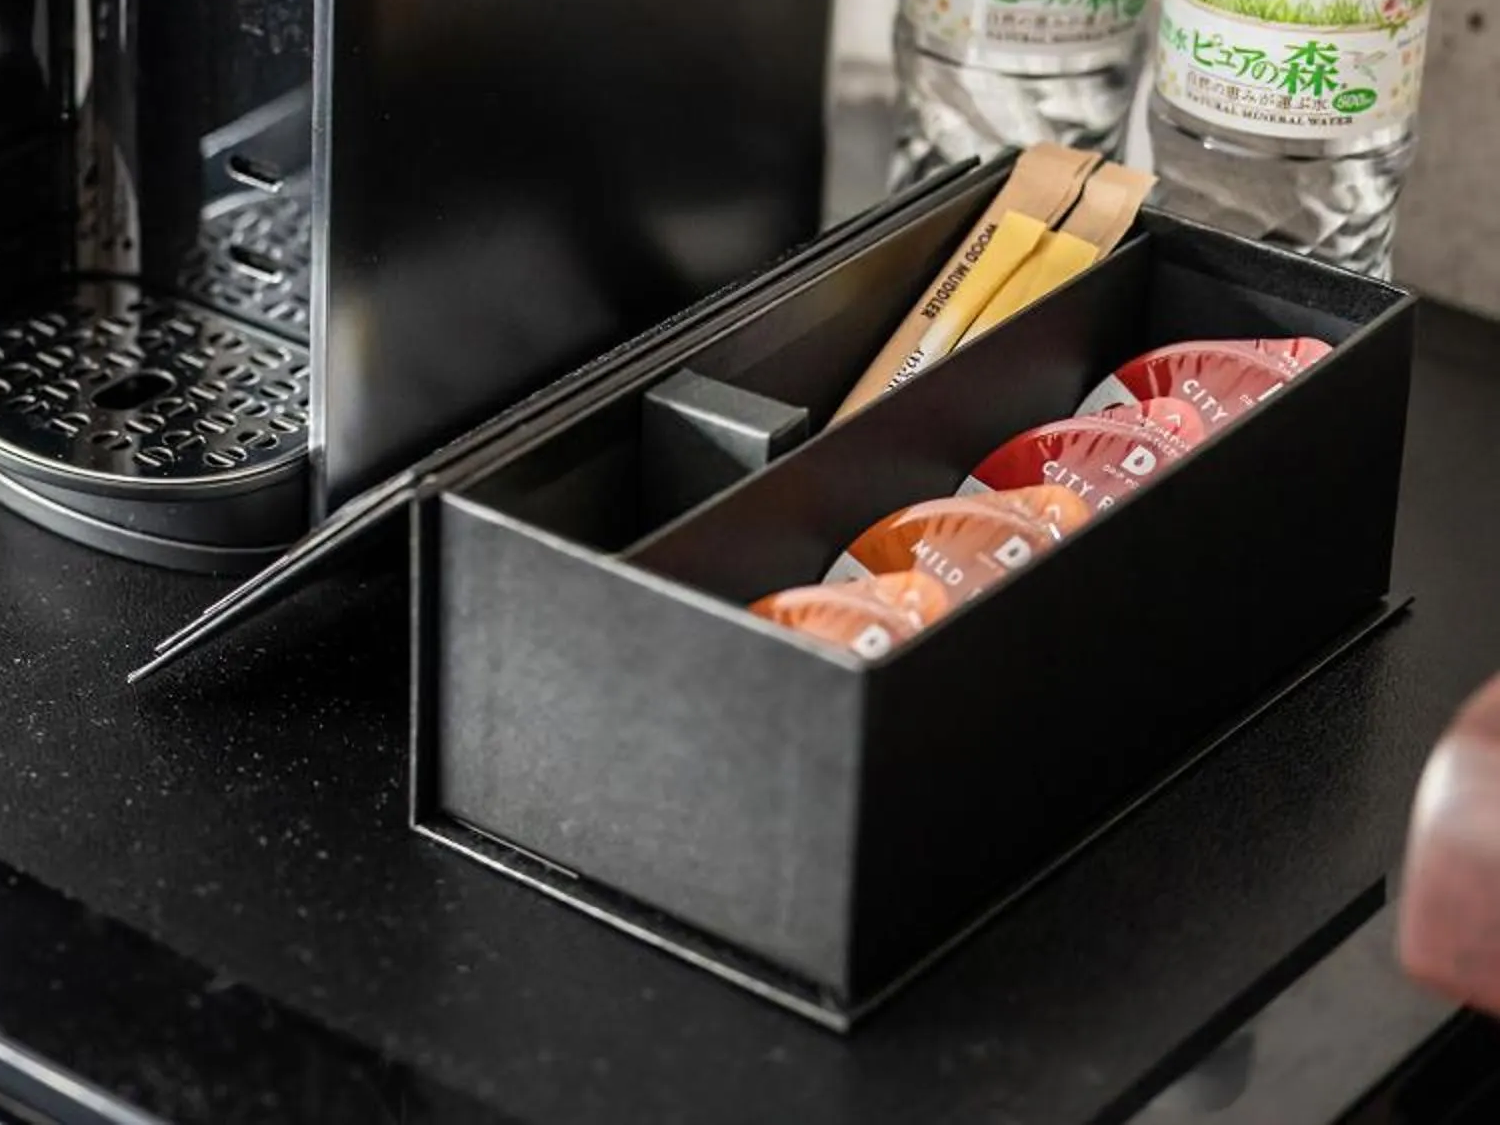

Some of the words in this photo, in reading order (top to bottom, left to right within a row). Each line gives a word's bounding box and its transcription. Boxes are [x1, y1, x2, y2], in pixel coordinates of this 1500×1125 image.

[1193, 29, 1339, 97] ピュアの森
[964, 223, 998, 263] WOOD
[920, 262, 970, 319] MUDDLER
[1182, 379, 1228, 423] CITY
[1042, 460, 1094, 497] CITY
[910, 538, 964, 586] MILD
